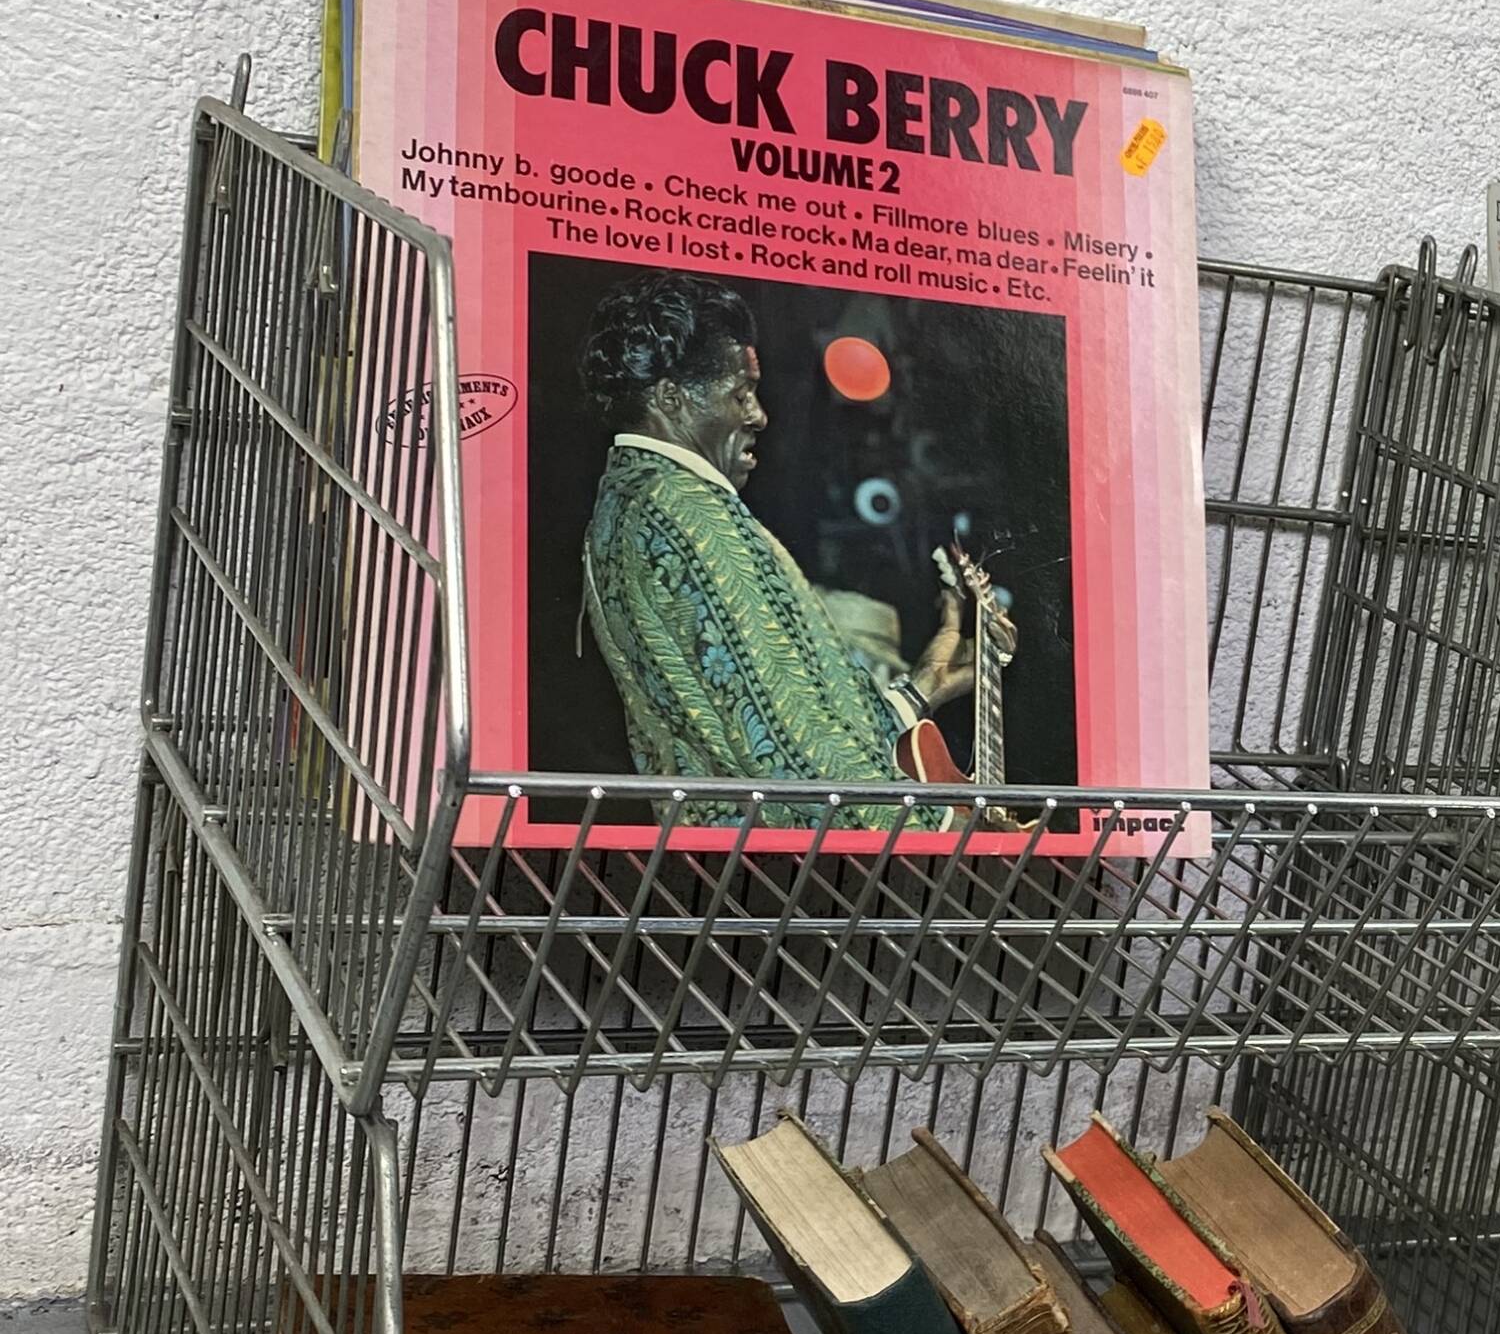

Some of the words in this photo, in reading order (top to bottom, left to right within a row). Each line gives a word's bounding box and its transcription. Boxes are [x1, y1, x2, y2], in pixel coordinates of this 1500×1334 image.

[495, 8, 797, 135] CHUCK
[826, 59, 1089, 178] BERRY
[401, 139, 504, 176] Johnny
[515, 154, 538, 178] b.
[550, 163, 636, 190] goode
[664, 175, 748, 206] Check
[757, 192, 796, 212] me
[806, 199, 847, 220] out
[873, 204, 968, 237] Fillmore
[978, 219, 1039, 247] blues
[1064, 230, 1138, 262] Misery
[731, 137, 874, 191] VOLUME
[879, 160, 901, 195] 2
[401, 167, 444, 198] My
[449, 175, 608, 216] tambourine
[625, 198, 692, 228] Rock
[697, 215, 777, 239] cradle
[782, 224, 837, 247] rock
[852, 229, 889, 254] Ma
[894, 236, 951, 266] dear,
[957, 248, 992, 268] ma
[997, 250, 1048, 275] dear
[1140, 267, 1155, 288] it
[546, 217, 598, 244] The
[606, 225, 661, 253] love
[667, 232, 673, 254] I
[682, 235, 730, 261] lost
[751, 243, 817, 273] Rock
[822, 258, 868, 279] and
[874, 263, 911, 285] roll
[918, 269, 988, 294] music
[1007, 277, 1052, 302] Etc.
